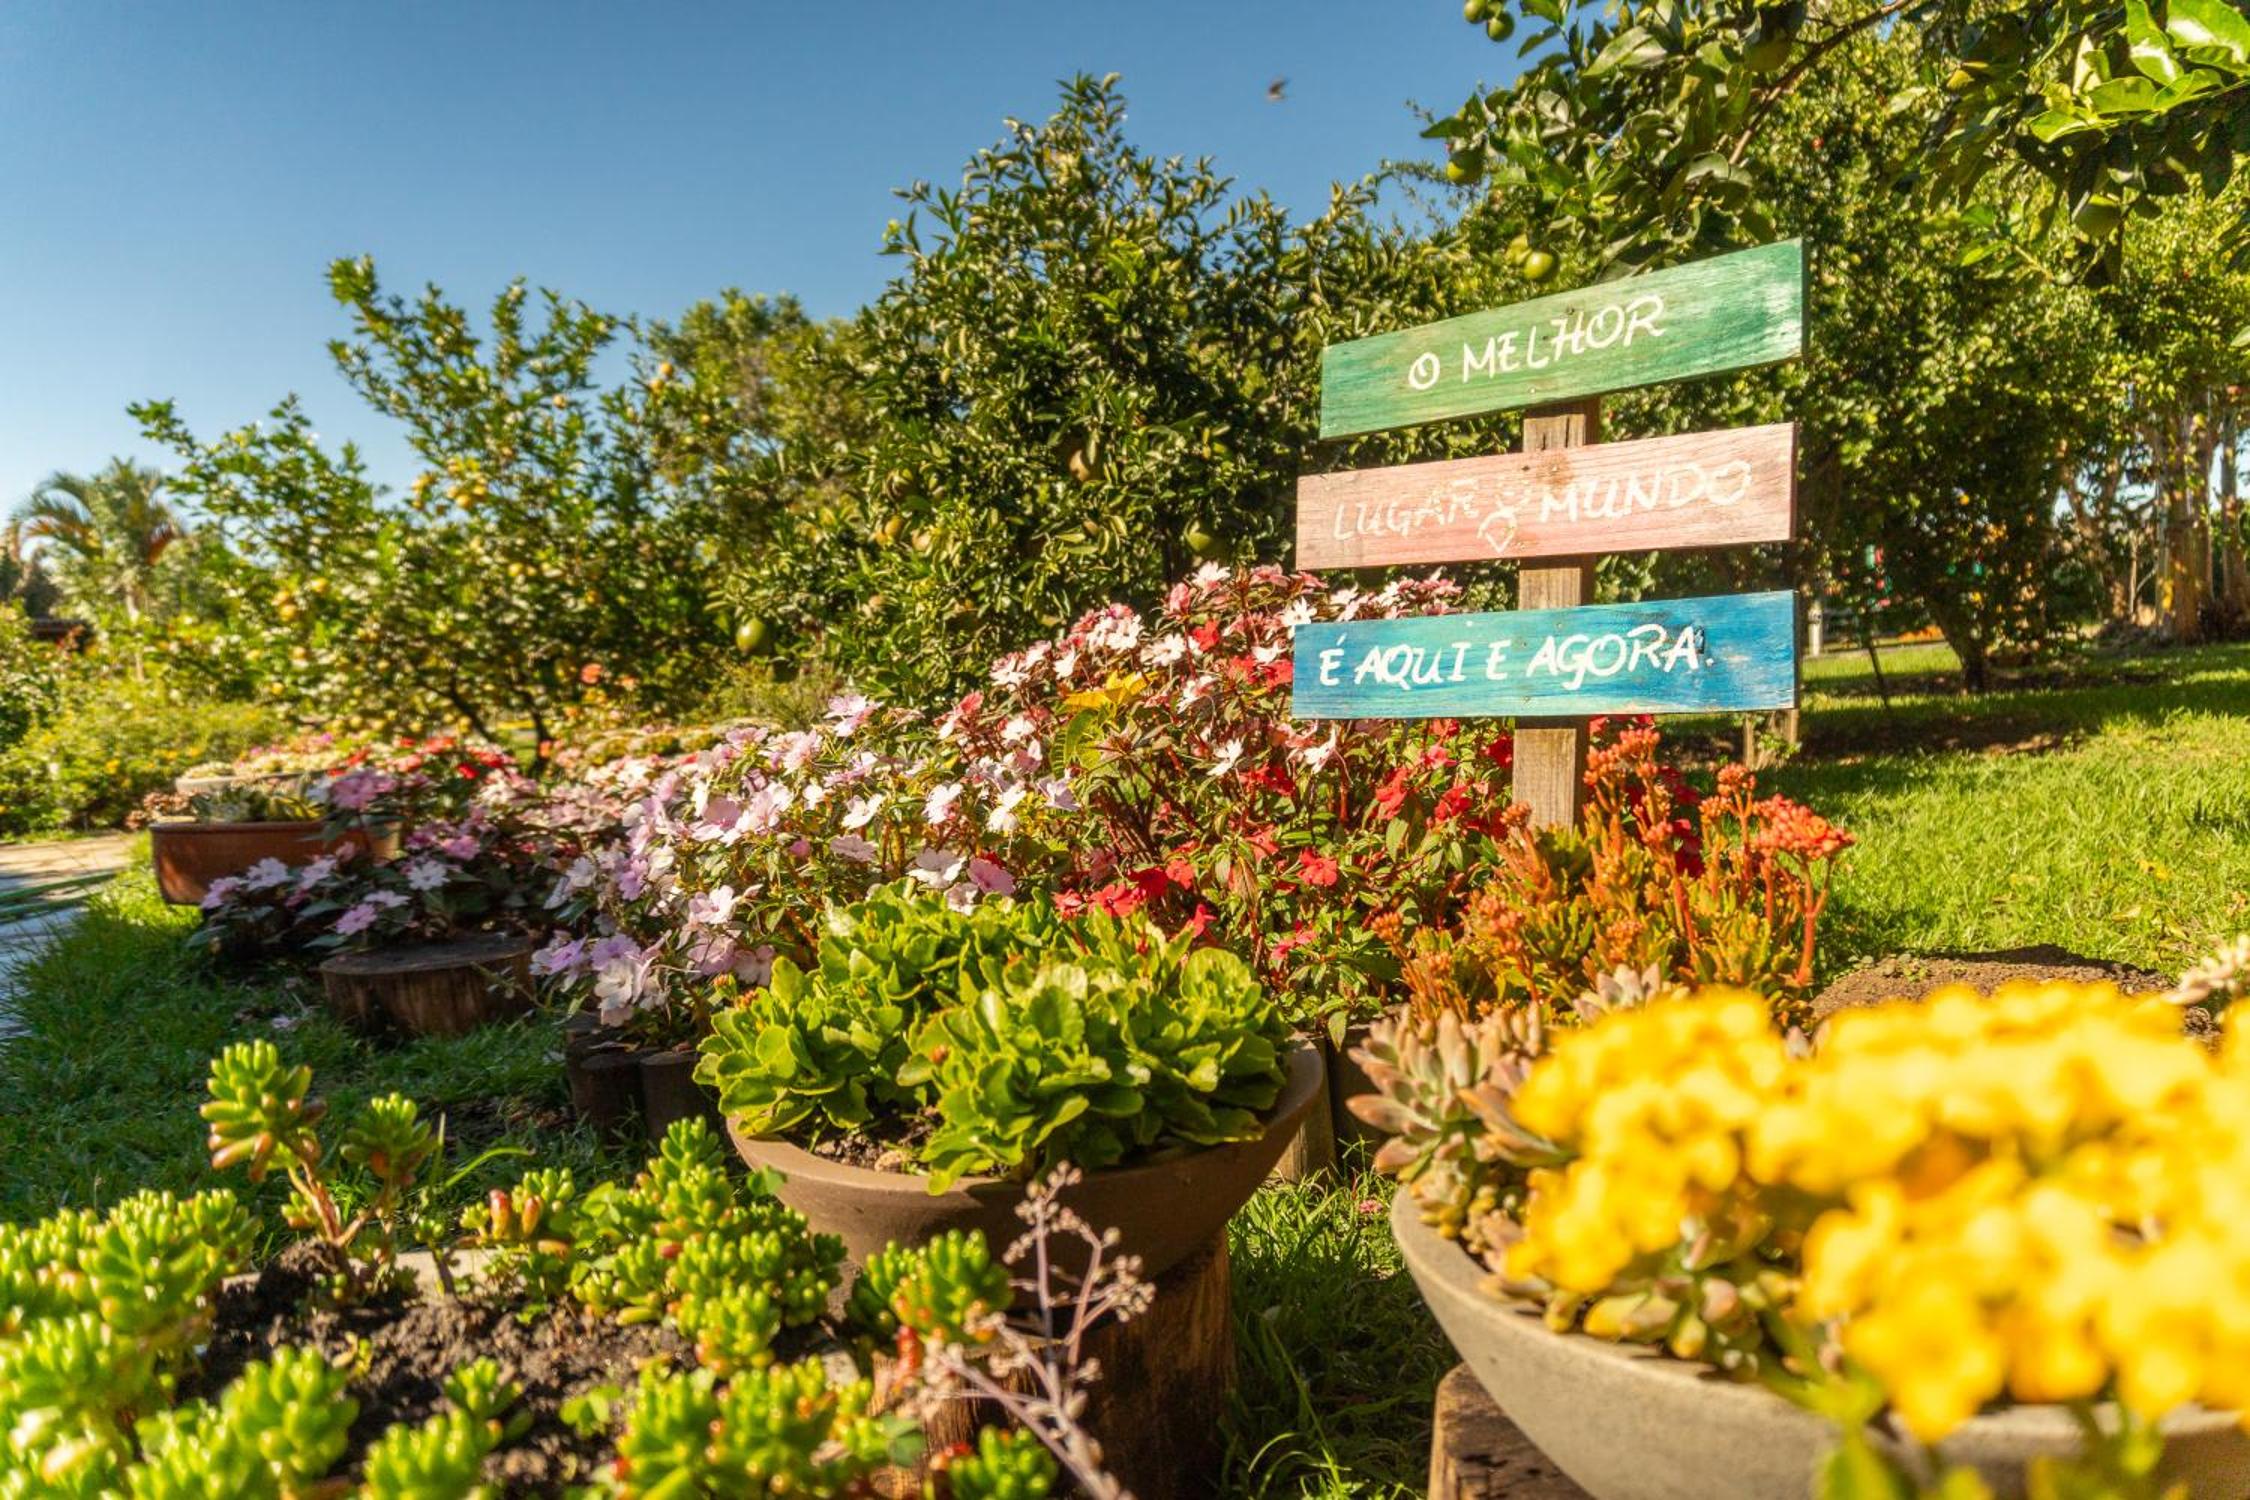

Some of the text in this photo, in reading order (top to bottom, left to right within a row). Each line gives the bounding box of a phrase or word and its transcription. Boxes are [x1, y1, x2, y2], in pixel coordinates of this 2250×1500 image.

[1409, 296, 1666, 390] O MELHOR
[1333, 479, 1479, 541] LUGAR
[1538, 460, 1751, 524] MUNDO
[1320, 635, 1347, 686] É
[1354, 642, 1468, 691] AQUI
[1486, 640, 1512, 680] E
